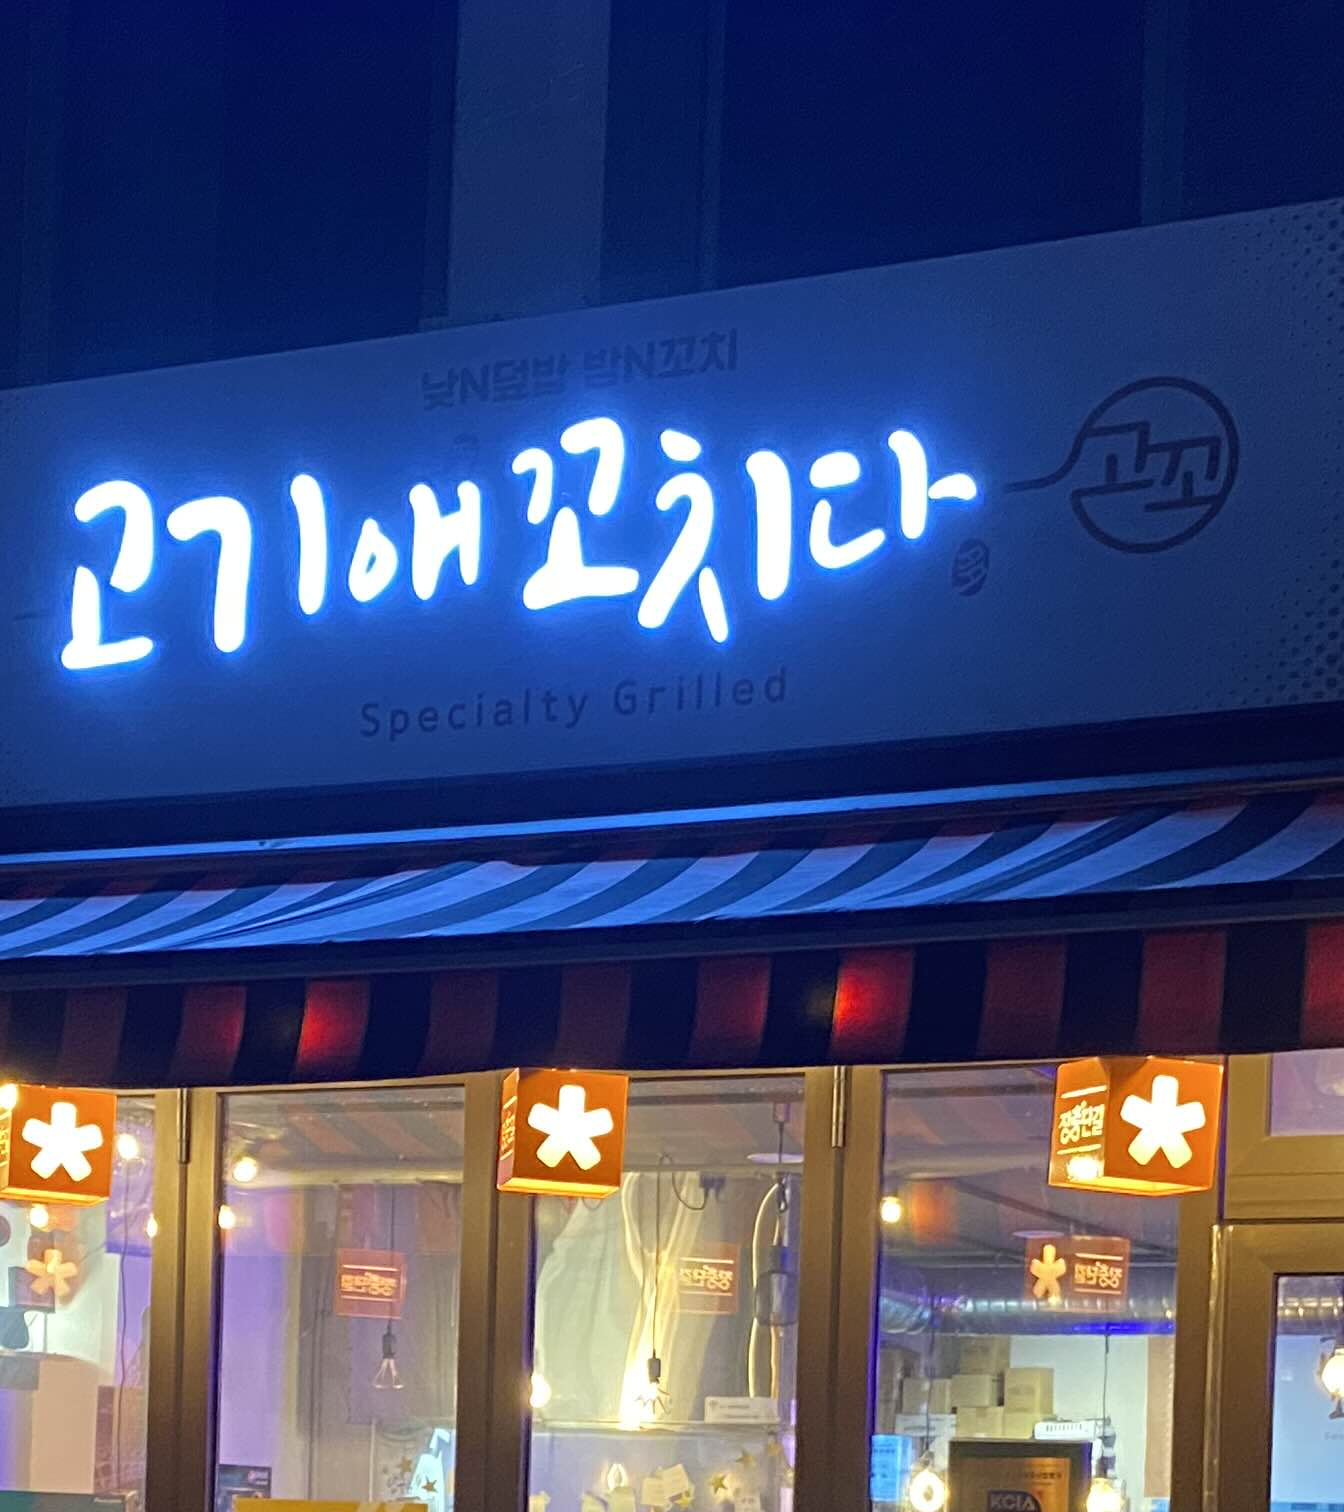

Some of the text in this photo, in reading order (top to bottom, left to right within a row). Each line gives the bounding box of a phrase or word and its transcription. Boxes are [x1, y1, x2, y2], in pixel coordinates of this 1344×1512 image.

[420, 327, 740, 411] 낮N덮밥 밤N꼬치
[359, 666, 789, 744] Specialty Grilled
[989, 1495, 1036, 1510] KCIA
